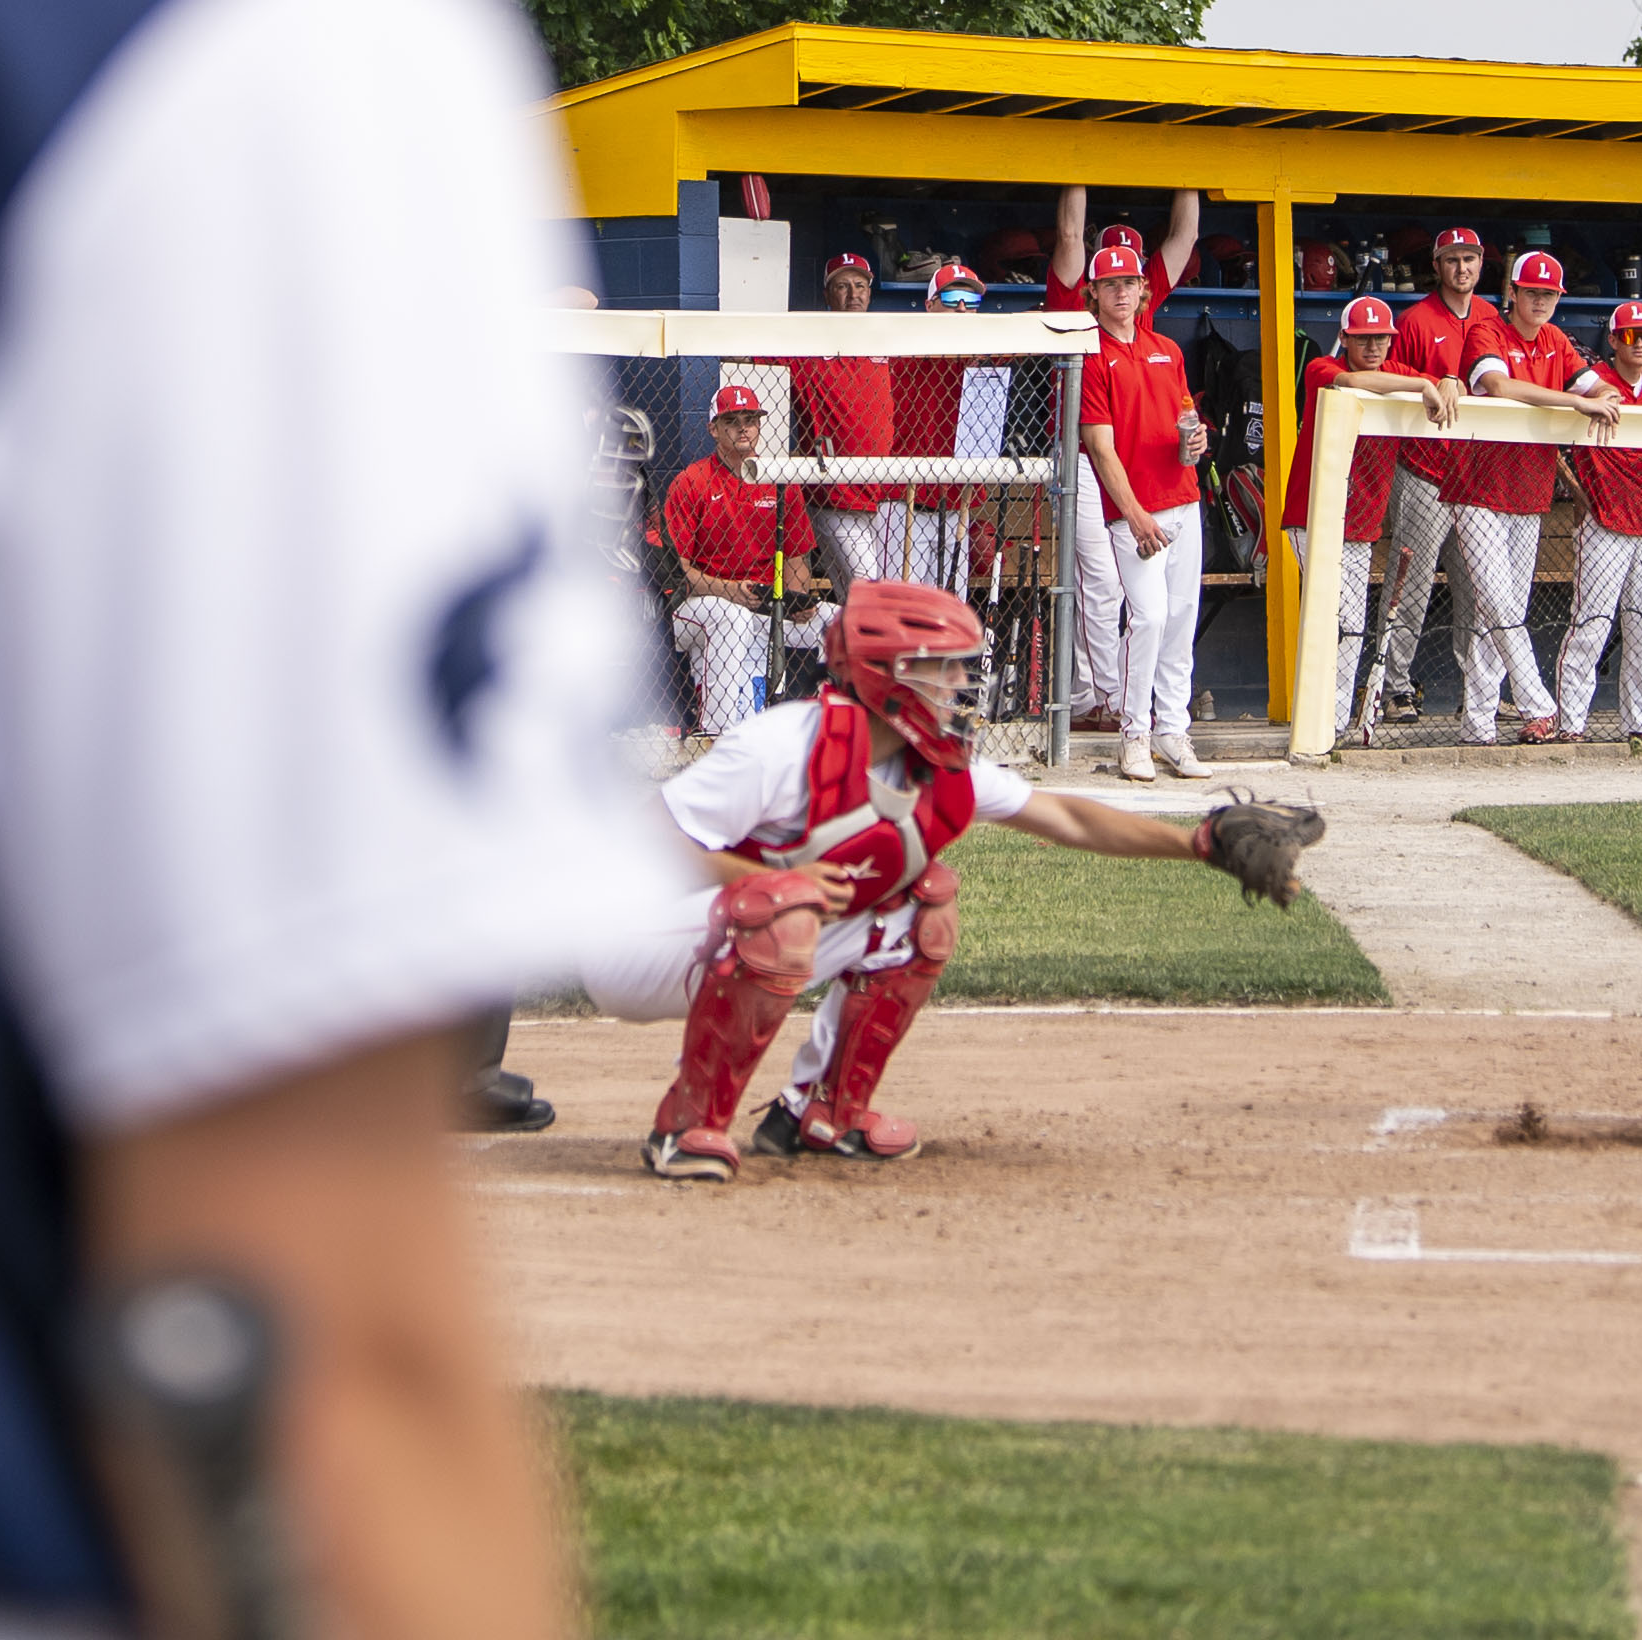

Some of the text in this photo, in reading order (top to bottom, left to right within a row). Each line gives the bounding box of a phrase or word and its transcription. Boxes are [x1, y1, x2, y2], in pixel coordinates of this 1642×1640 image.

[1119, 231, 1132, 246] L
[1452, 230, 1464, 244] L
[842, 253, 855, 265] L
[1110, 252, 1124, 268] L
[952, 264, 966, 279] L
[1538, 262, 1550, 279] L
[1366, 306, 1379, 323] L
[734, 389, 748, 406] L
